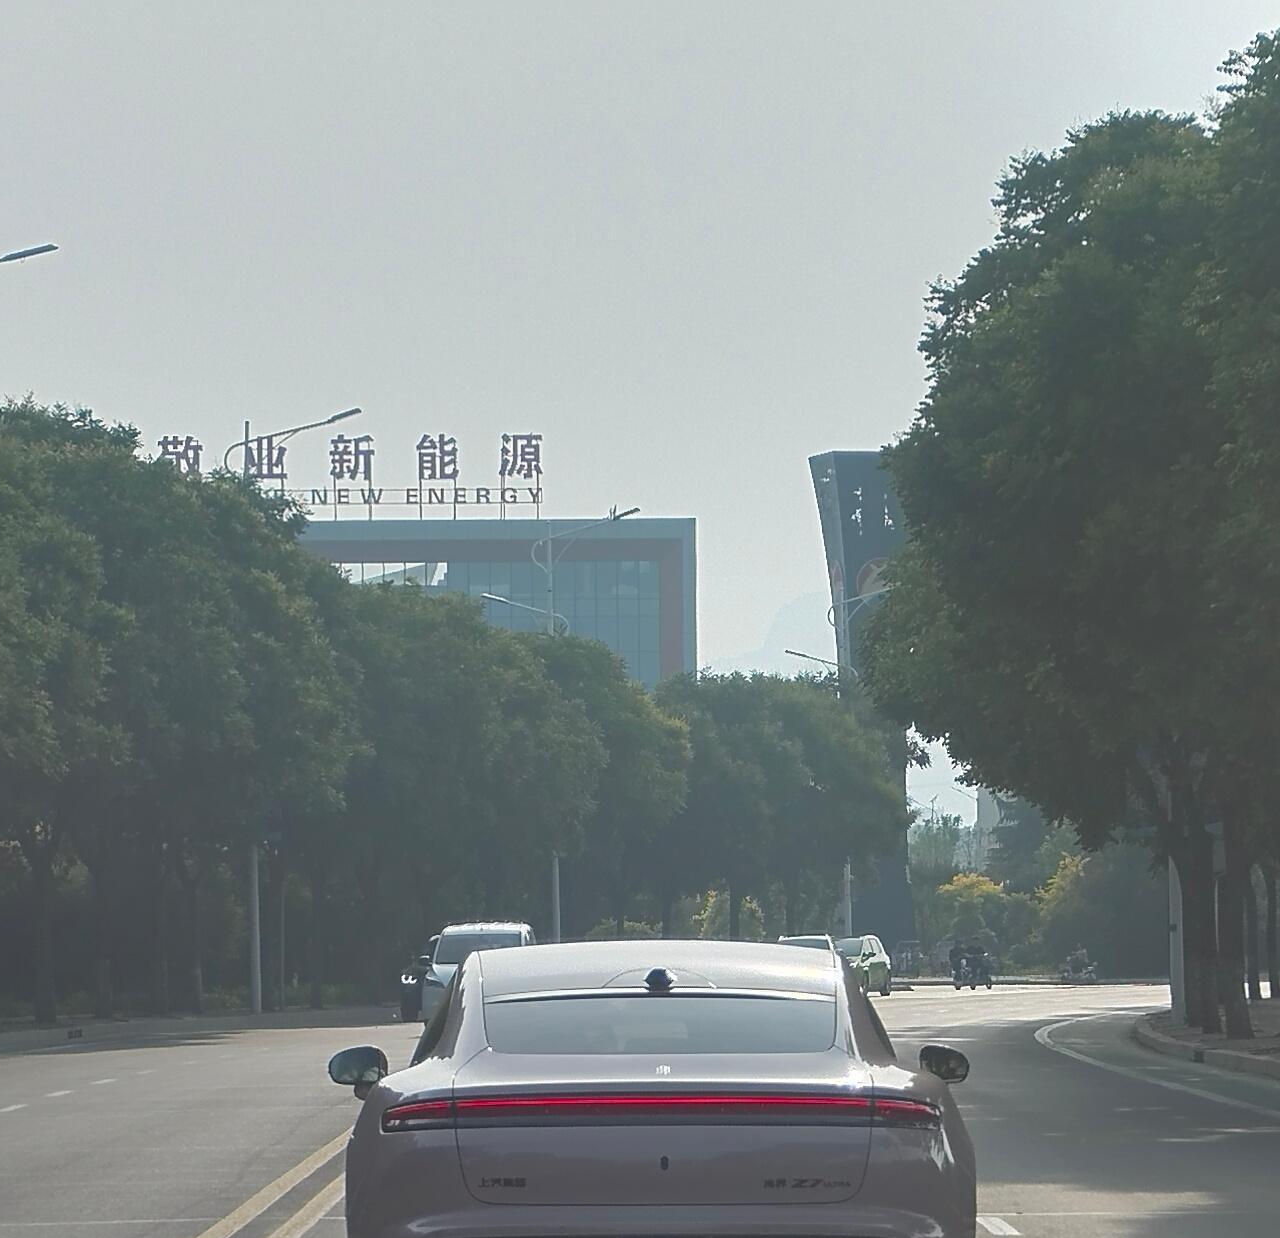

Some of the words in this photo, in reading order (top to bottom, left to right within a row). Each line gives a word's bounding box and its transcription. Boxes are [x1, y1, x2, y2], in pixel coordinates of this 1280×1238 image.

[157, 433, 544, 482] 敬业新能源
[311, 487, 383, 505] NEW
[406, 487, 543, 505] ENERGY
